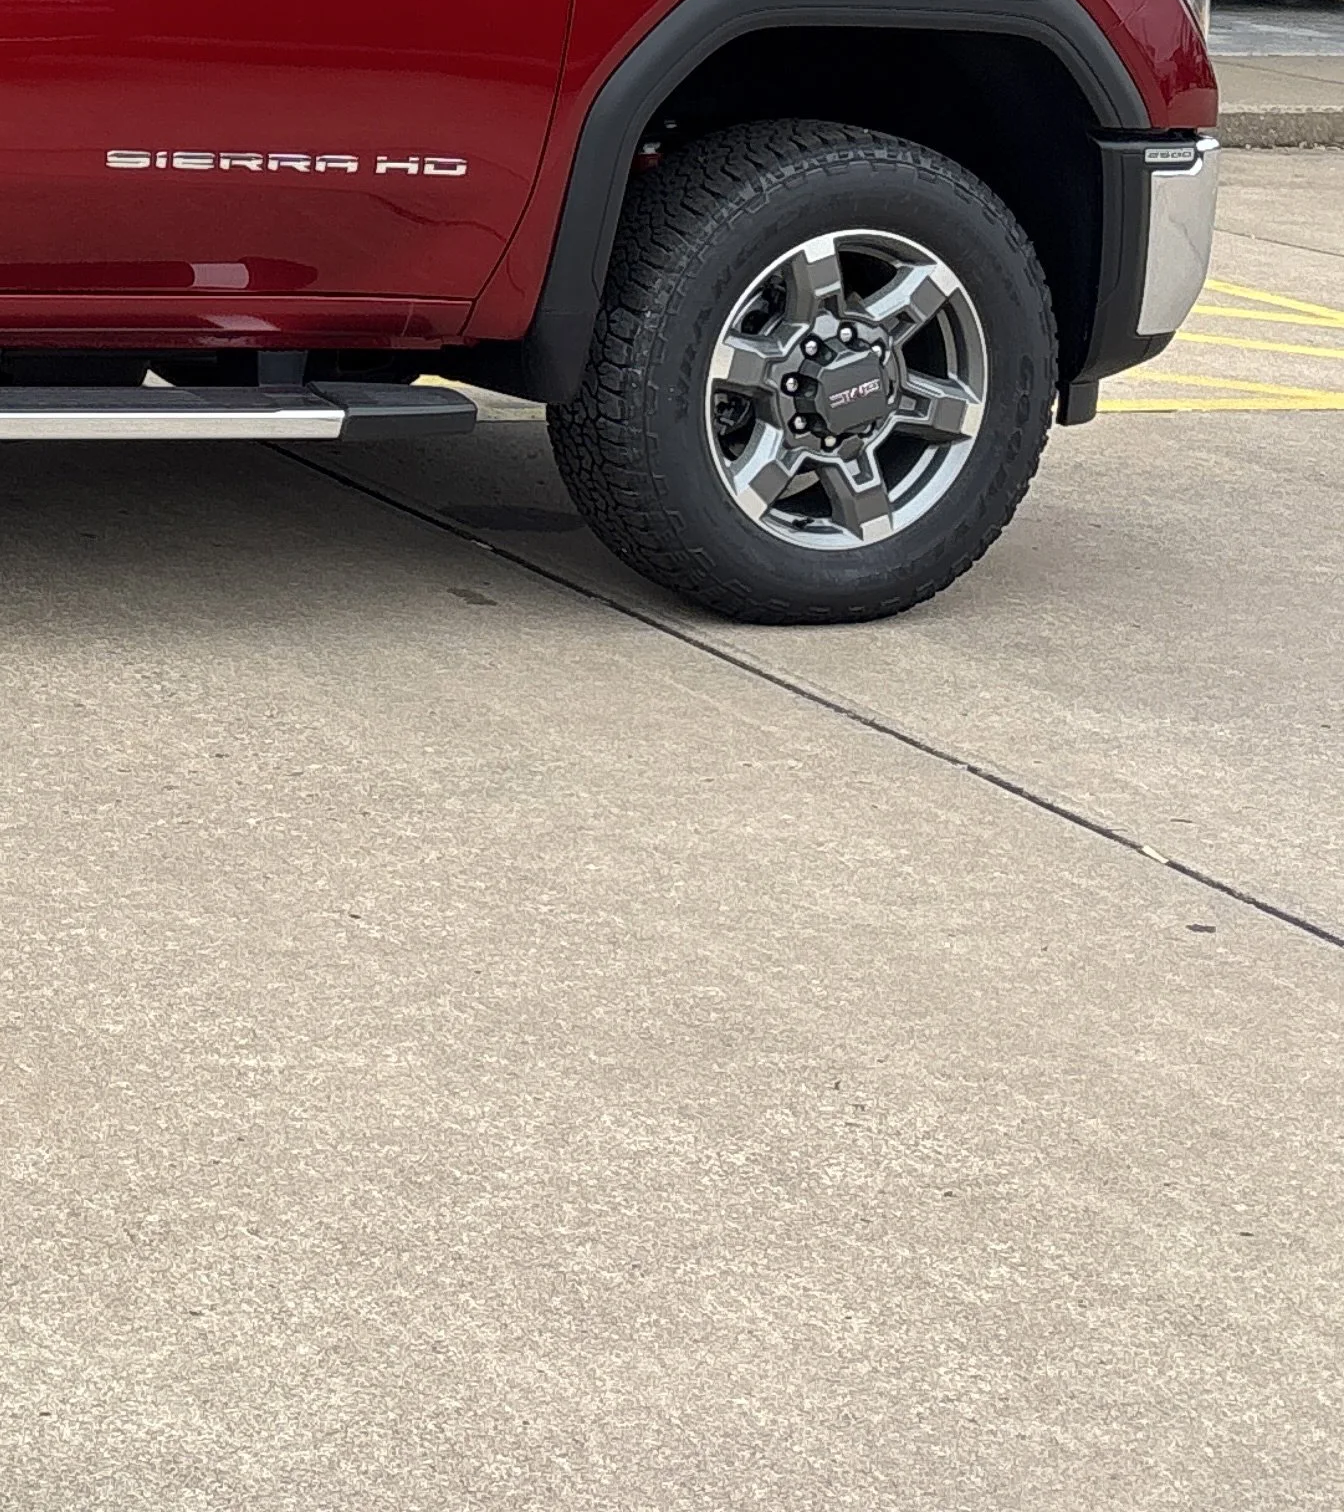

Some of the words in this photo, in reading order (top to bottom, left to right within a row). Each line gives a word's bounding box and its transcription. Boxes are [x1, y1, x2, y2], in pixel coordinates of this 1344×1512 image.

[105, 150, 360, 174] SIERRA
[374, 155, 468, 177] HD
[828, 377, 881, 409] GMC
